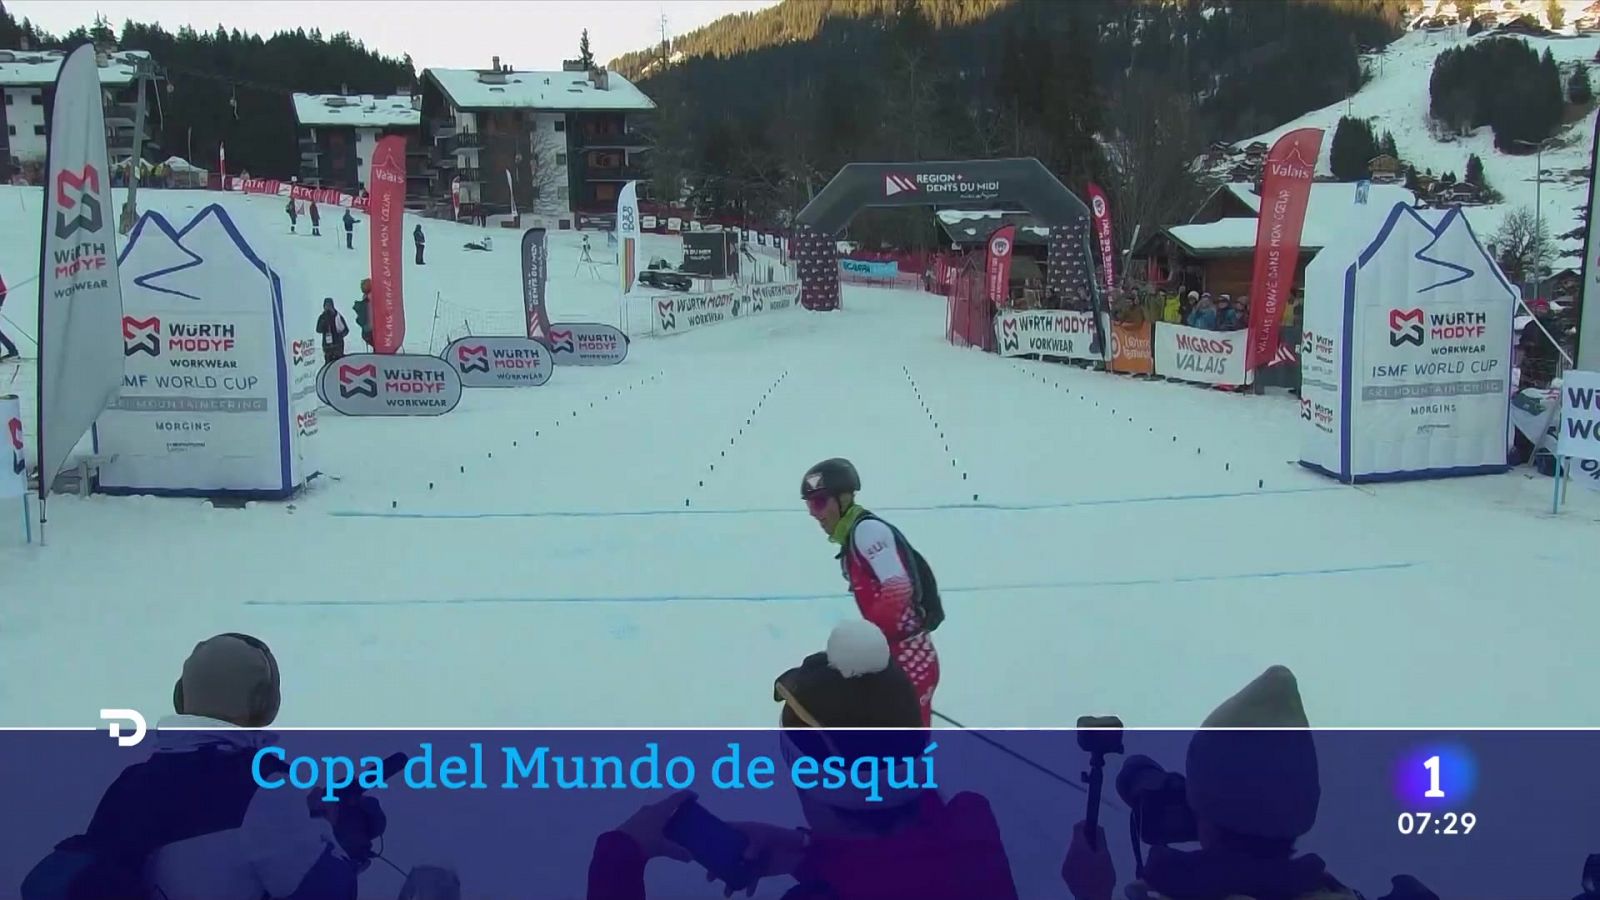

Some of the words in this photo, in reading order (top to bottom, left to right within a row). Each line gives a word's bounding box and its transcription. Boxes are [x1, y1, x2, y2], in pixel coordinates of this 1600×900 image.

[375, 169, 404, 184] Valais
[1271, 164, 1310, 179] Valais
[292, 187, 313, 198] ATK
[926, 184, 958, 192] DENTS
[960, 183, 975, 192] DU
[976, 181, 999, 190] MIDI
[169, 323, 235, 338] WÜRTH
[1431, 326, 1486, 340] MODYF
[169, 339, 235, 352] MODYF
[578, 342, 617, 350] MODYF
[1176, 333, 1233, 354] MIGROS
[1431, 344, 1486, 355] WORKWEAR
[170, 359, 237, 369] WORKWEAR
[494, 360, 541, 368] MODYF
[1176, 353, 1228, 375] VALAIS
[1372, 365, 1408, 377] ISMF
[1414, 361, 1464, 375] WORLD
[1471, 360, 1498, 373] CUP
[384, 369, 445, 381] WÜRTH
[156, 375, 217, 389] WORLD
[223, 375, 258, 390] CUP
[385, 382, 446, 393] MODYF
[386, 399, 447, 407] WORKWEAR
[155, 422, 211, 432] MORGINS
